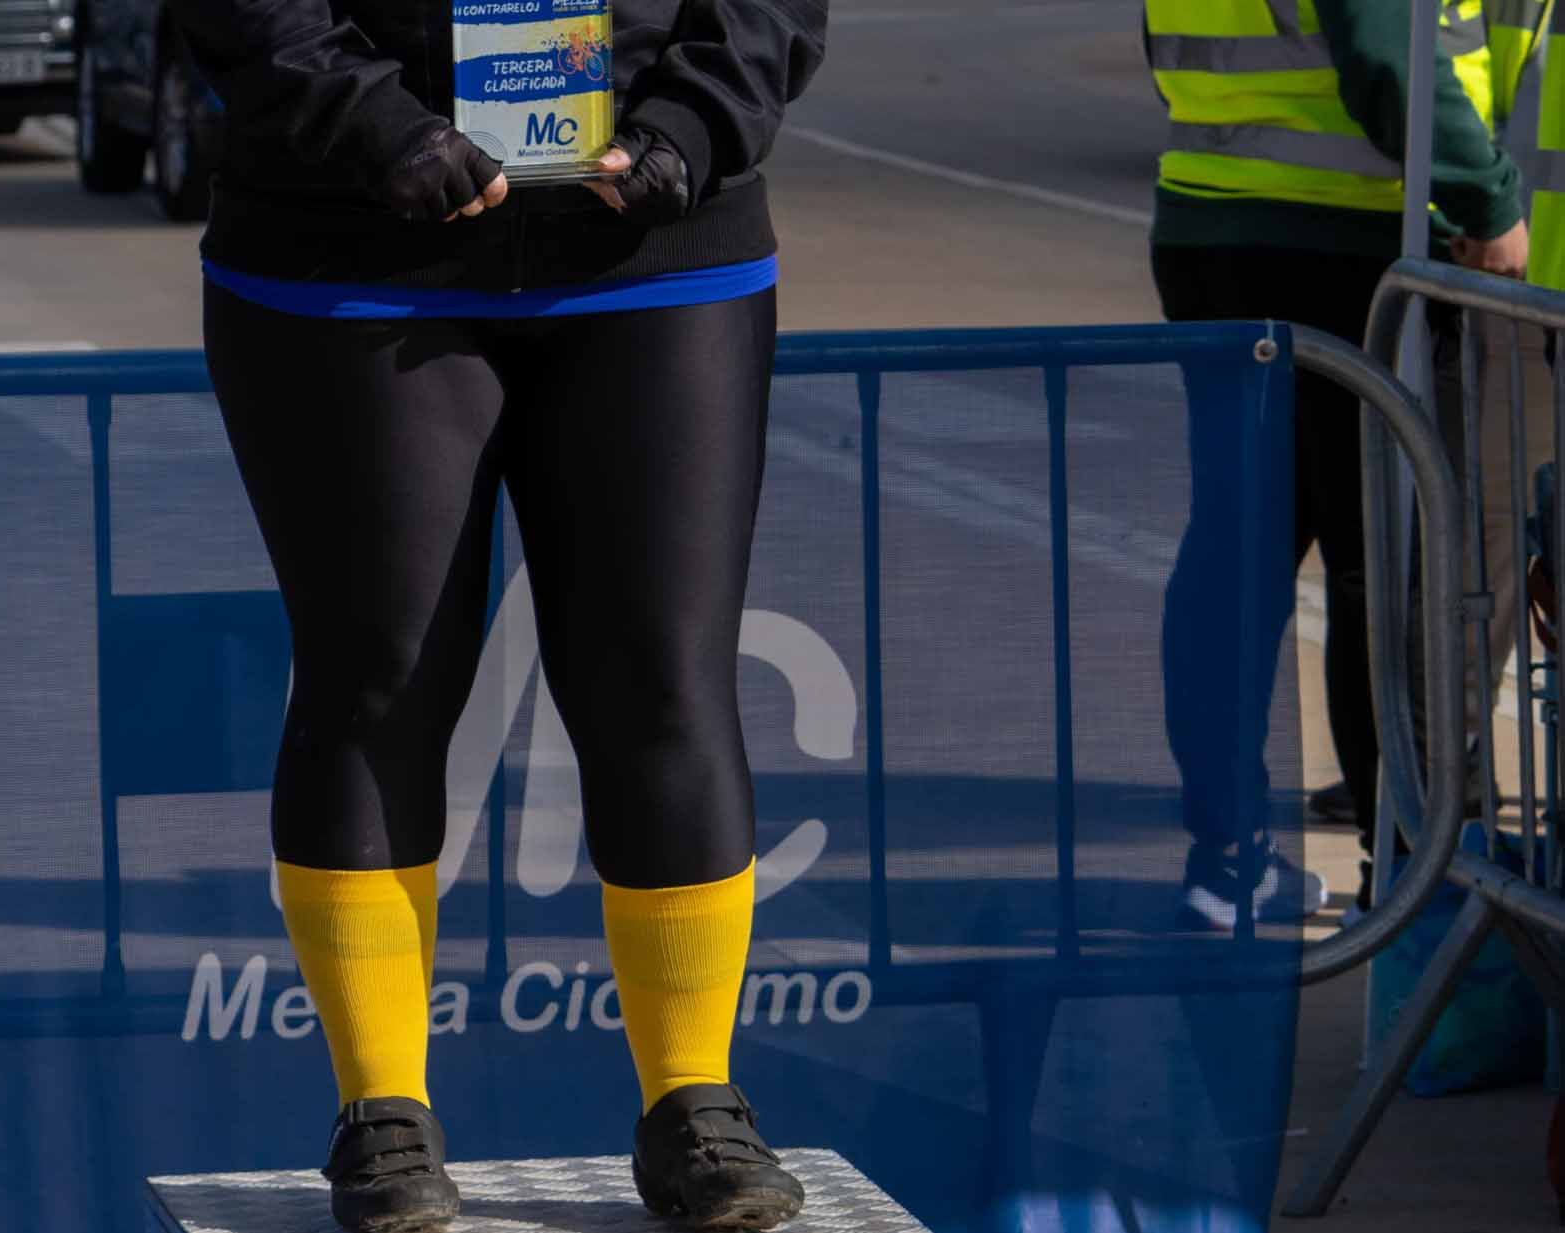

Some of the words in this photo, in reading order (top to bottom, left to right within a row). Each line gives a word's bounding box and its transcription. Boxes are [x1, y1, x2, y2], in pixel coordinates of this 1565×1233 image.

[463, 1, 540, 17] CONTRARELOJ
[492, 60, 553, 75] TERCERA
[484, 76, 566, 93] CLASIFICADA
[500, 959, 873, 1035] Cicmo
